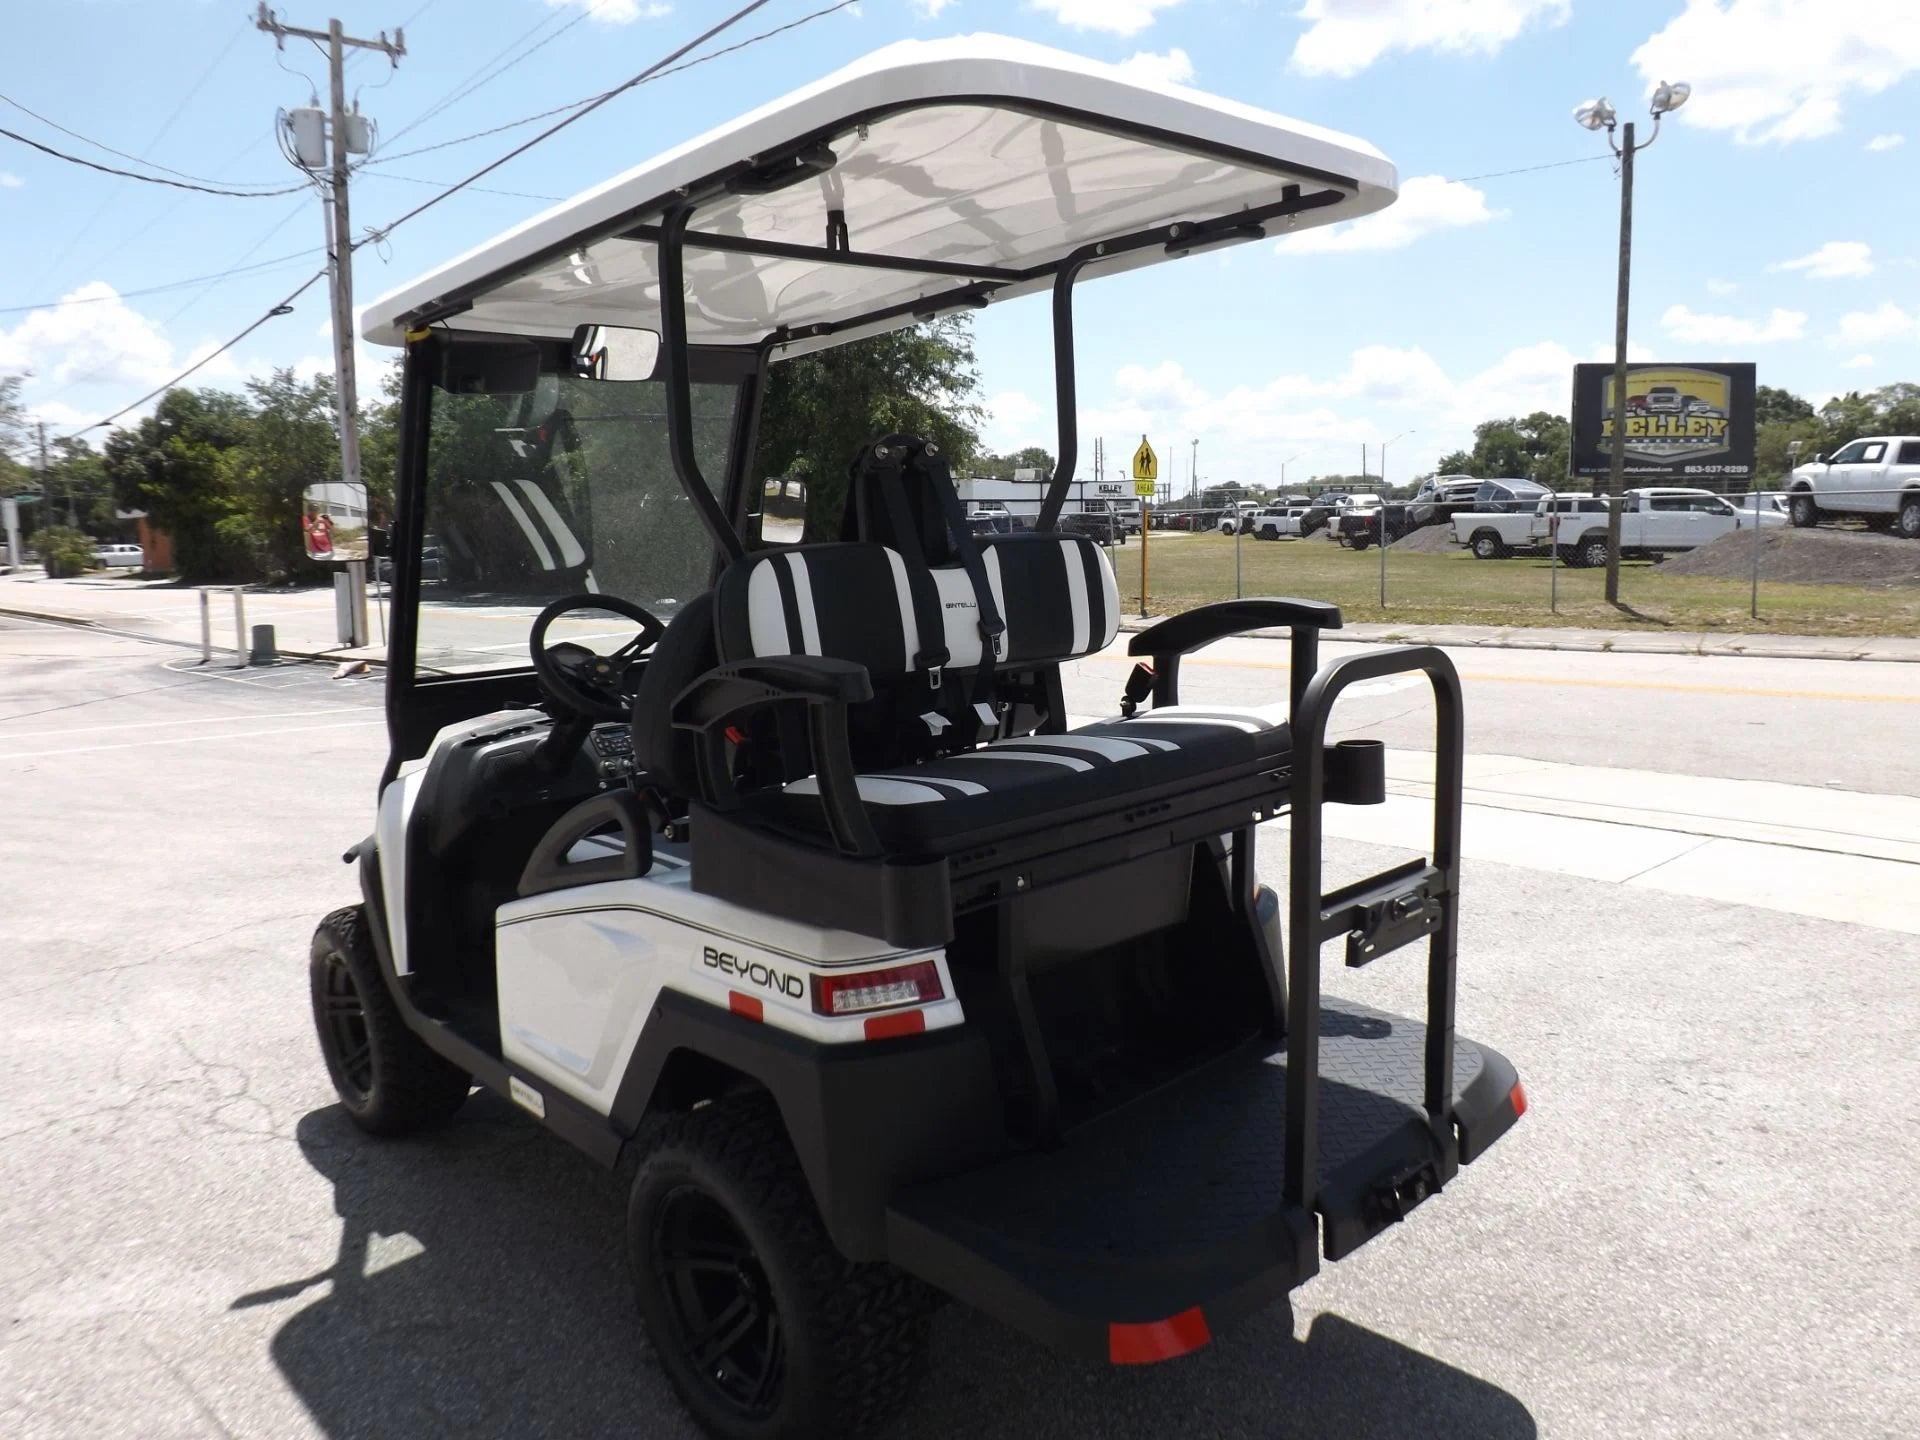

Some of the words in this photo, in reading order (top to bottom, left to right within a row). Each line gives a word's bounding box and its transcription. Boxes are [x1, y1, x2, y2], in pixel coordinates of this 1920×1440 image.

[1099, 484, 1122, 493] KELLEY
[1136, 483, 1153, 494] AHEAD
[703, 945, 804, 999] BEYOND
